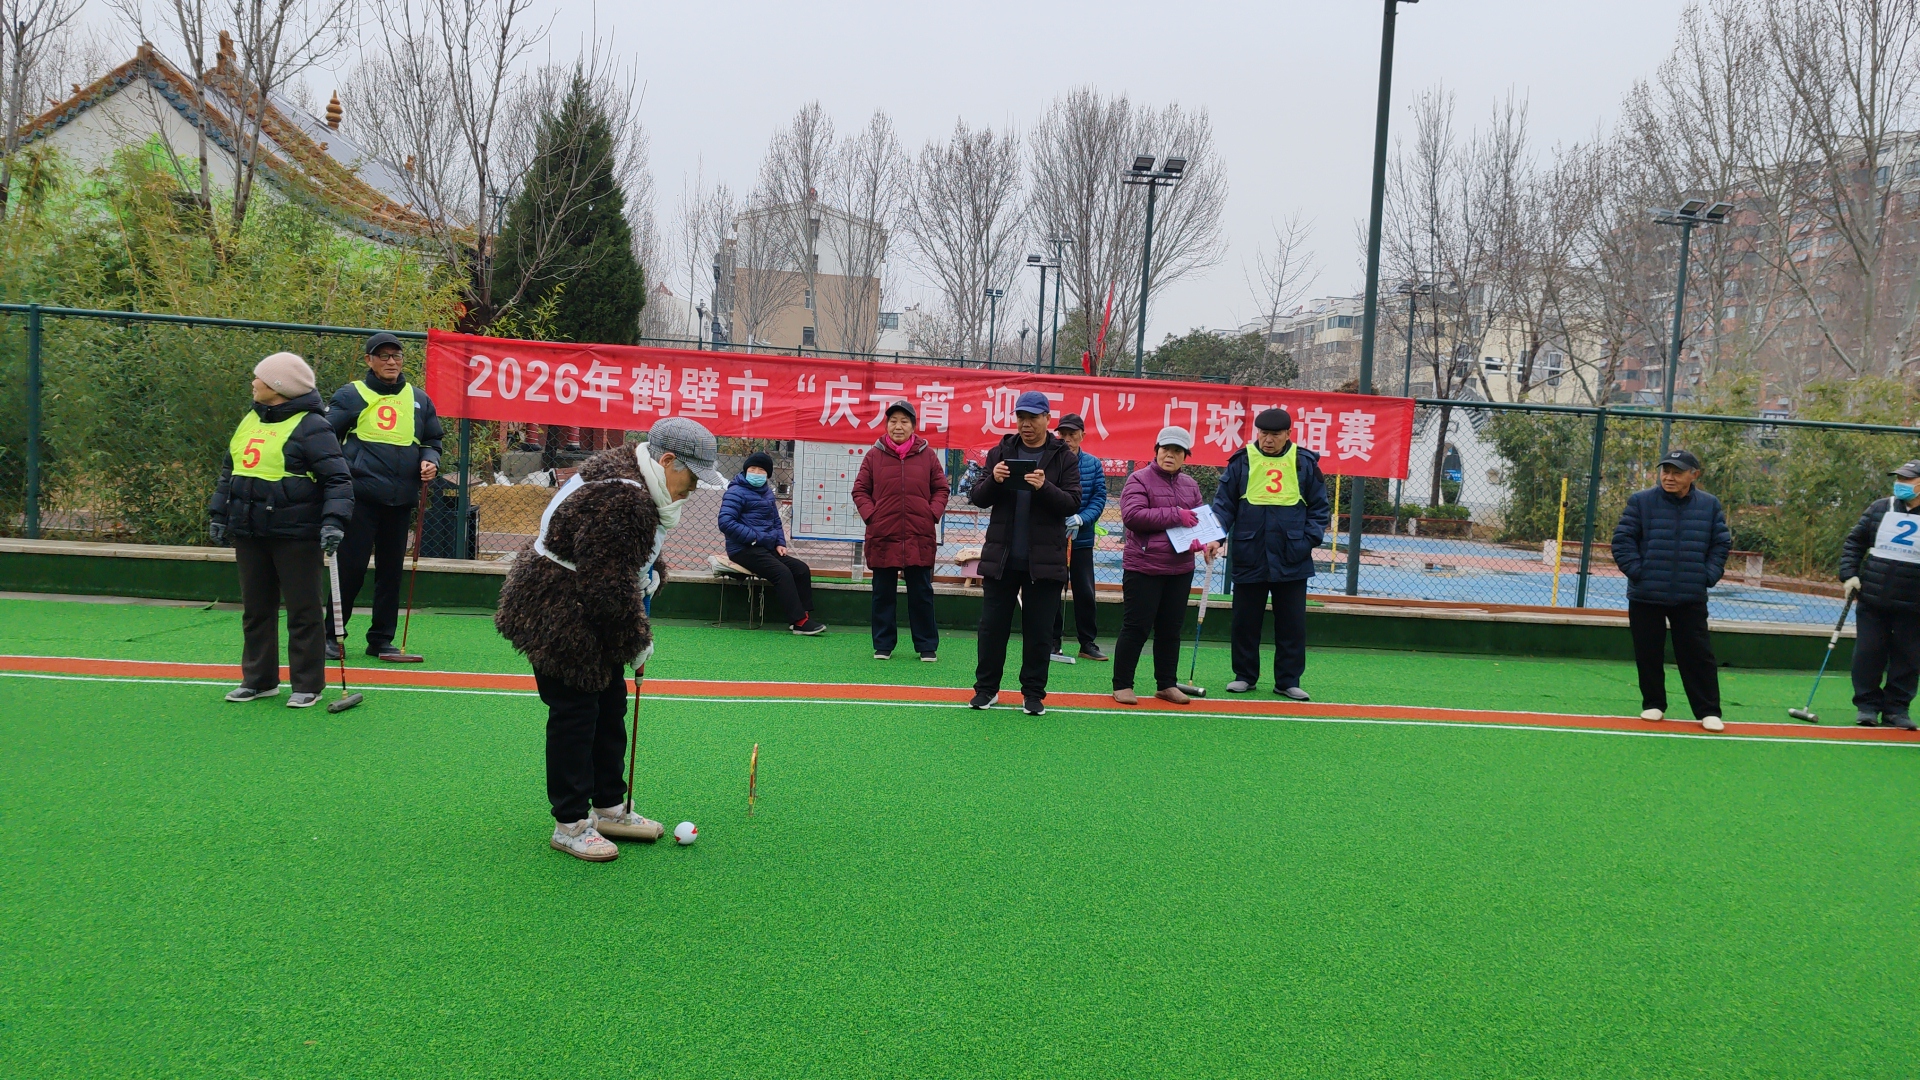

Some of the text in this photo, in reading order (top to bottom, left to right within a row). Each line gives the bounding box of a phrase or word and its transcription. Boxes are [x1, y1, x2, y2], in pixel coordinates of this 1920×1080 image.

[377, 405, 397, 431] 9
[242, 438, 266, 469] 5
[1265, 468, 1283, 494] 3
[1890, 520, 1919, 547] 2
